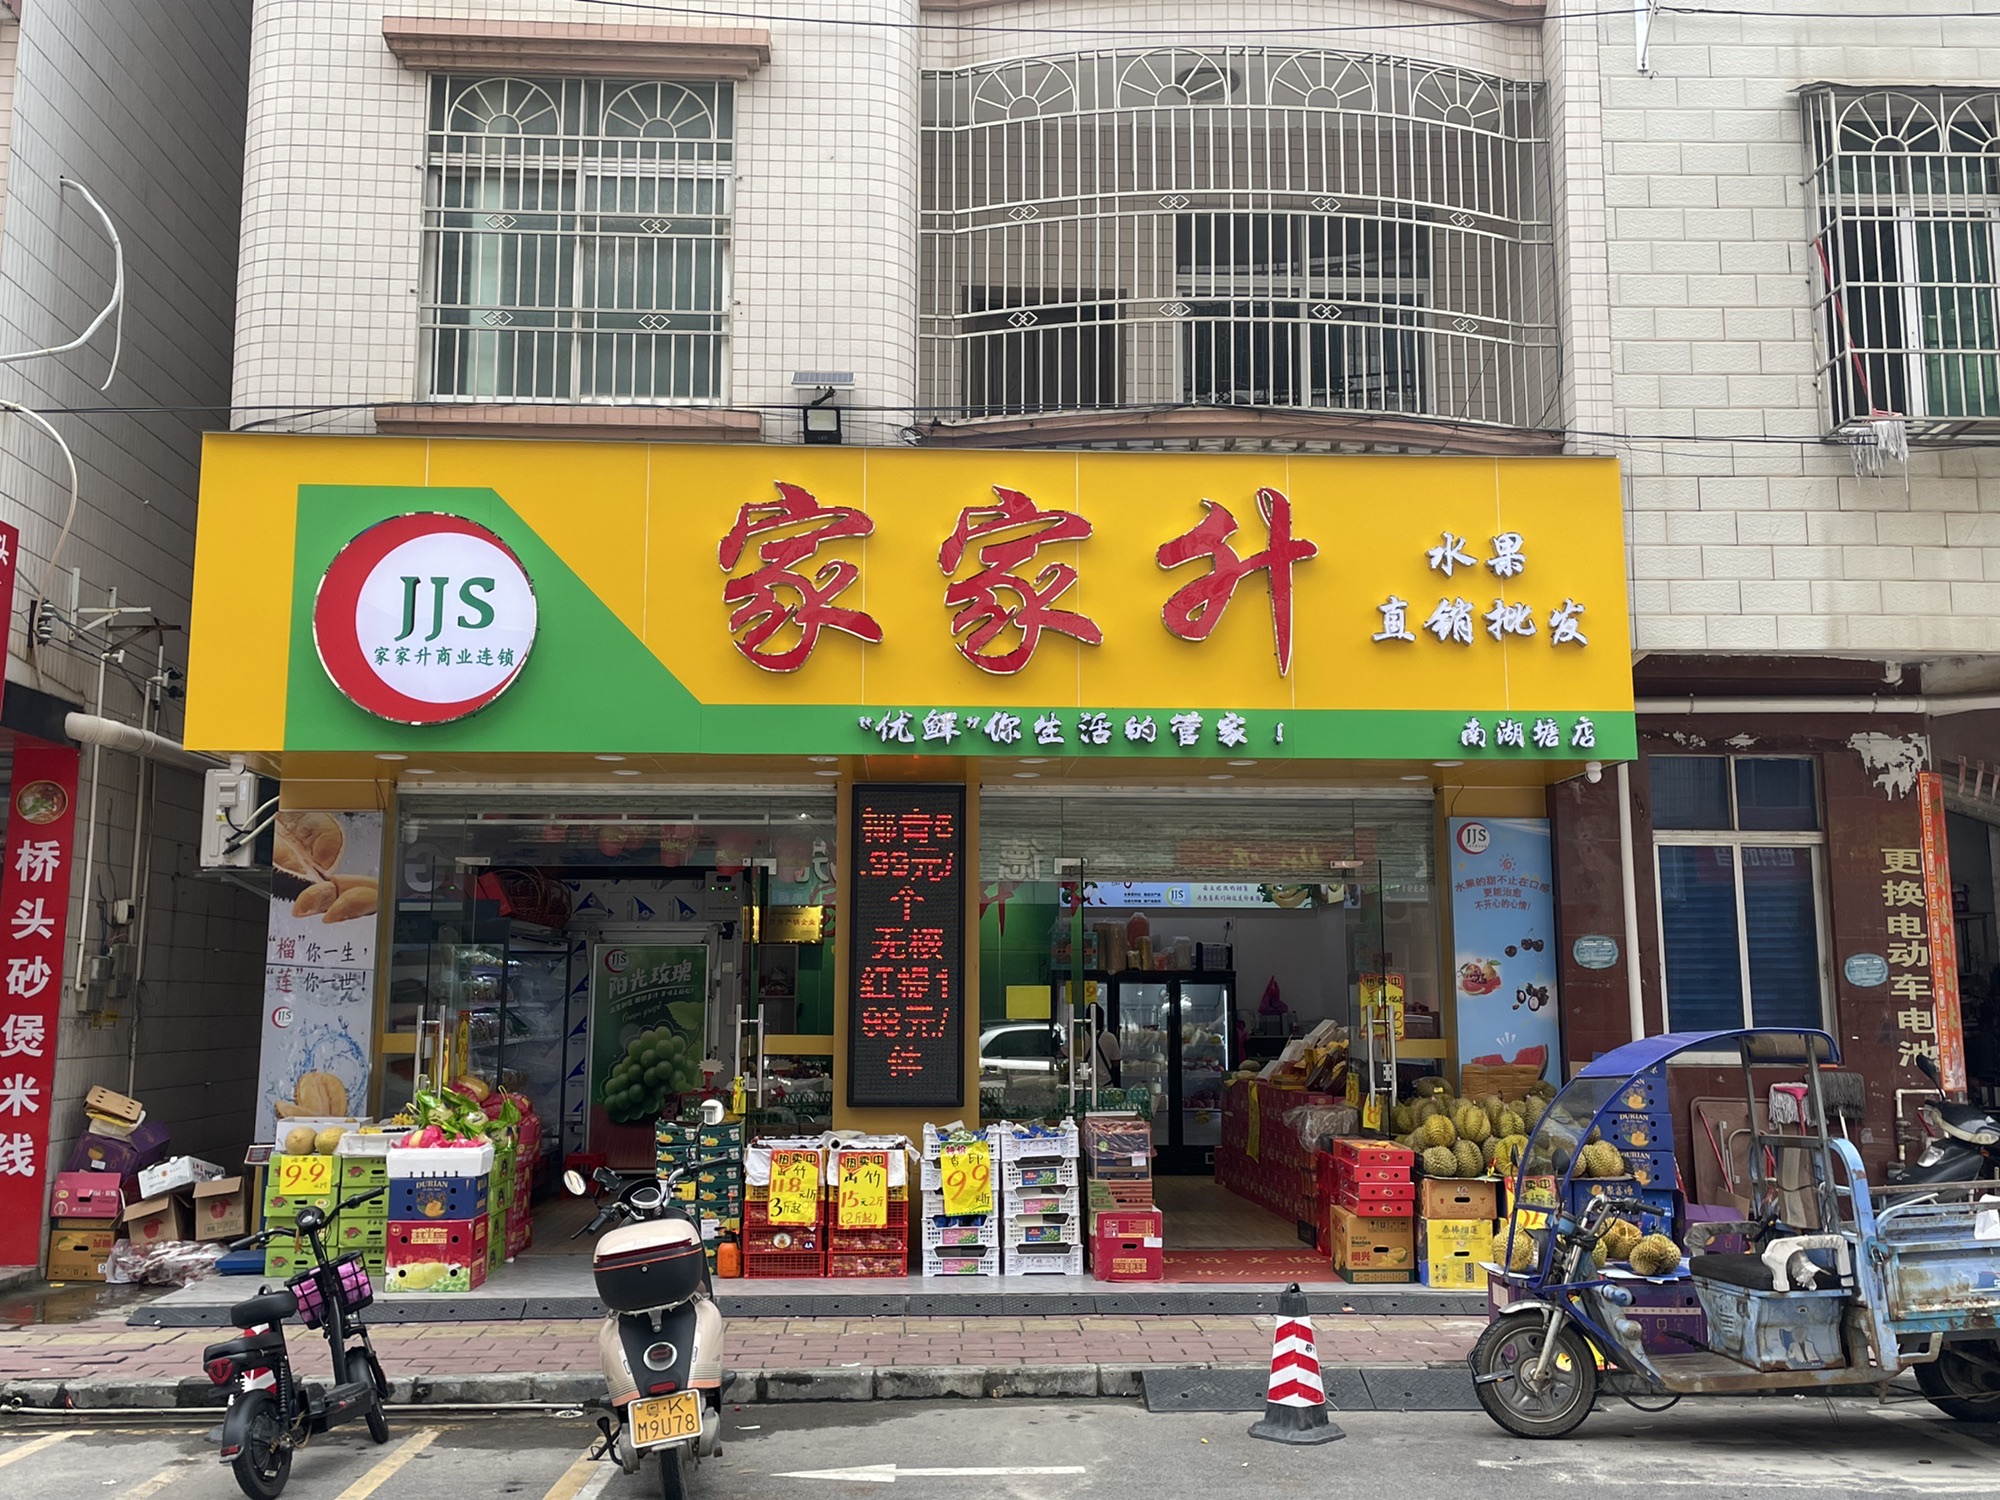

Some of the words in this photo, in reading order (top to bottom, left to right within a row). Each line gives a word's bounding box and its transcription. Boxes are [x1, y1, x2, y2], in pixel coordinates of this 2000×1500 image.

[1426, 531, 1526, 579] 水果
[717, 479, 1319, 680] 家家升
[394, 576, 496, 642] JJS
[1371, 595, 1588, 648] 直销批发
[373, 645, 516, 668] 家家升商业连锁
[1460, 715, 1597, 751] 南湖塘店
[1466, 828, 1487, 845] JJS
[1170, 888, 1184, 900] JJS
[1455, 875, 1551, 893] 水果的甜不止在口感
[1484, 887, 1522, 898] 更能治愈
[612, 953, 627, 966] JJS
[1880, 847, 1941, 1072] 更换电动车电池
[609, 959, 692, 999] 阳光玫瑰
[0, 839, 61, 1178] 桥头砂煲米线
[277, 1010, 292, 1025] JJS
[1619, 1113, 1649, 1121] DURIAN
[779, 1152, 816, 1165] 热卖中
[846, 1155, 884, 1168] 热卖中
[416, 1180, 448, 1189] DURIAN
[638, 1415, 696, 1441] M9U78
